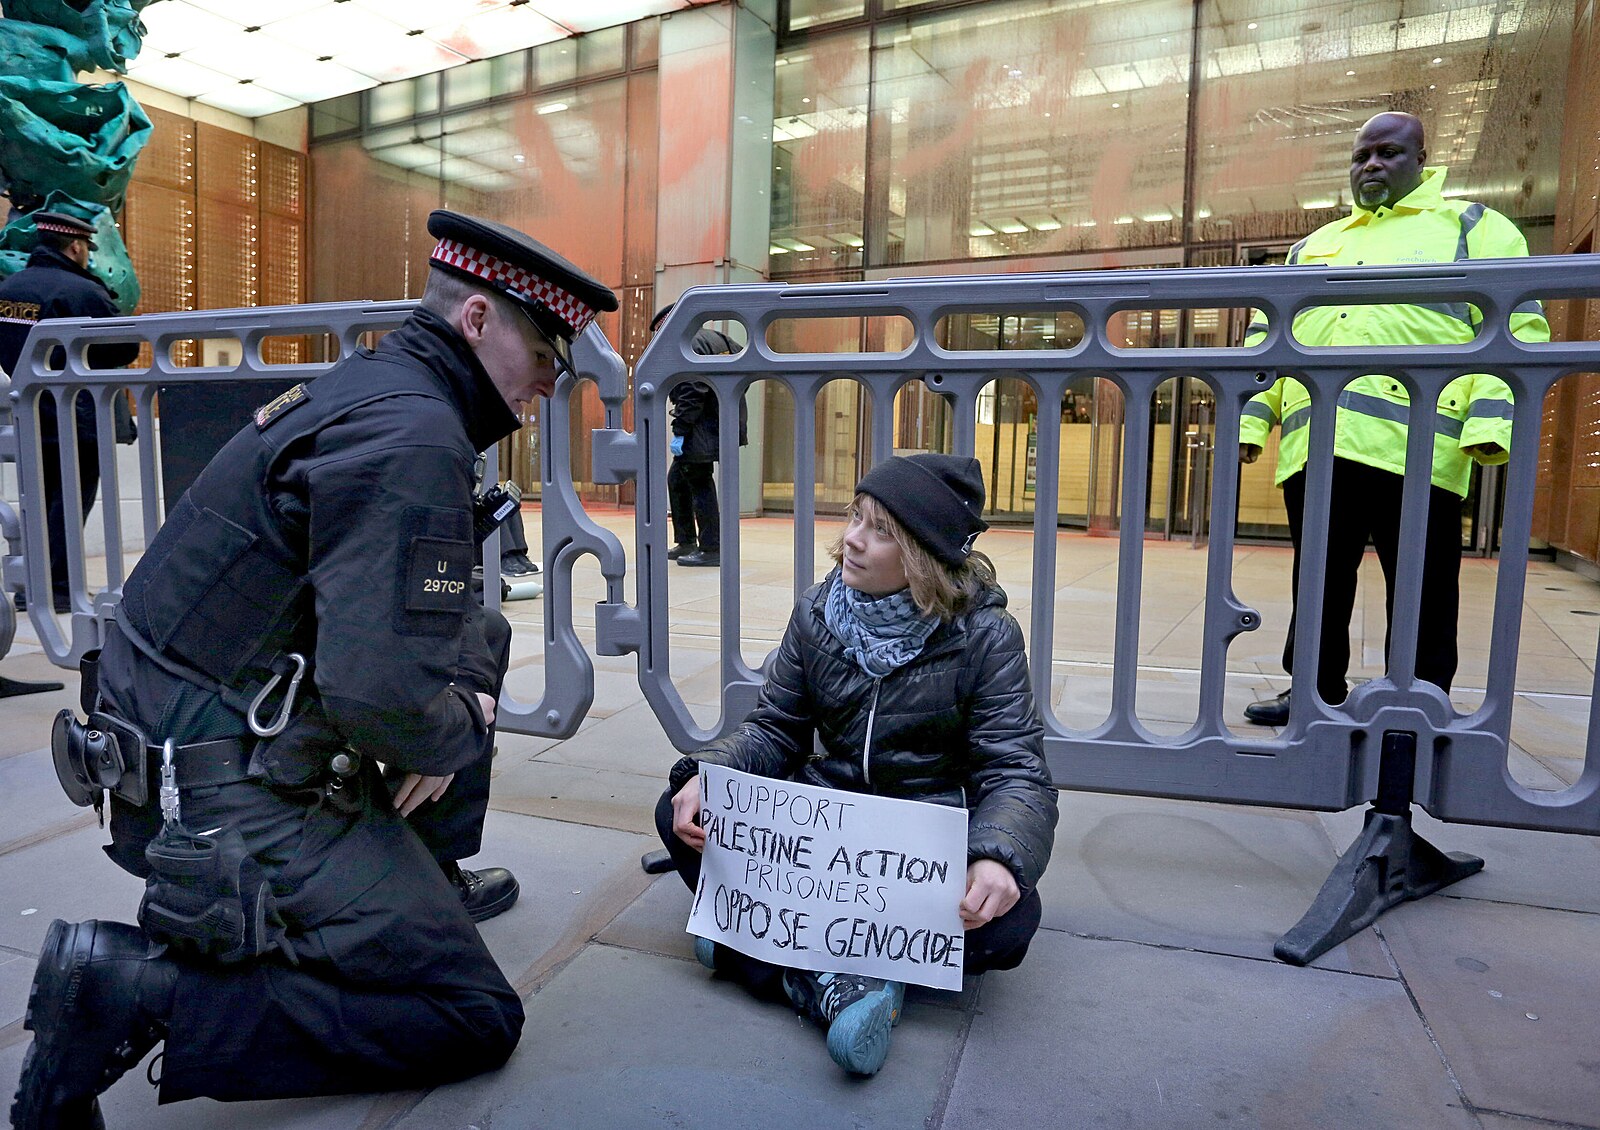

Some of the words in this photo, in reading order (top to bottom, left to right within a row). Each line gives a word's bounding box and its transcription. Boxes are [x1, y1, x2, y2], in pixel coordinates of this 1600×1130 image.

[423, 578, 465, 594] 297CP
[437, 560, 448, 574] U
[723, 778, 856, 832] SUPPORT
[701, 808, 814, 870] PALESTINE
[827, 845, 949, 885] ACTION
[744, 858, 889, 913] PRISONERS
[714, 883, 810, 951] OPPOSE
[824, 917, 964, 969] GENOCIDE
